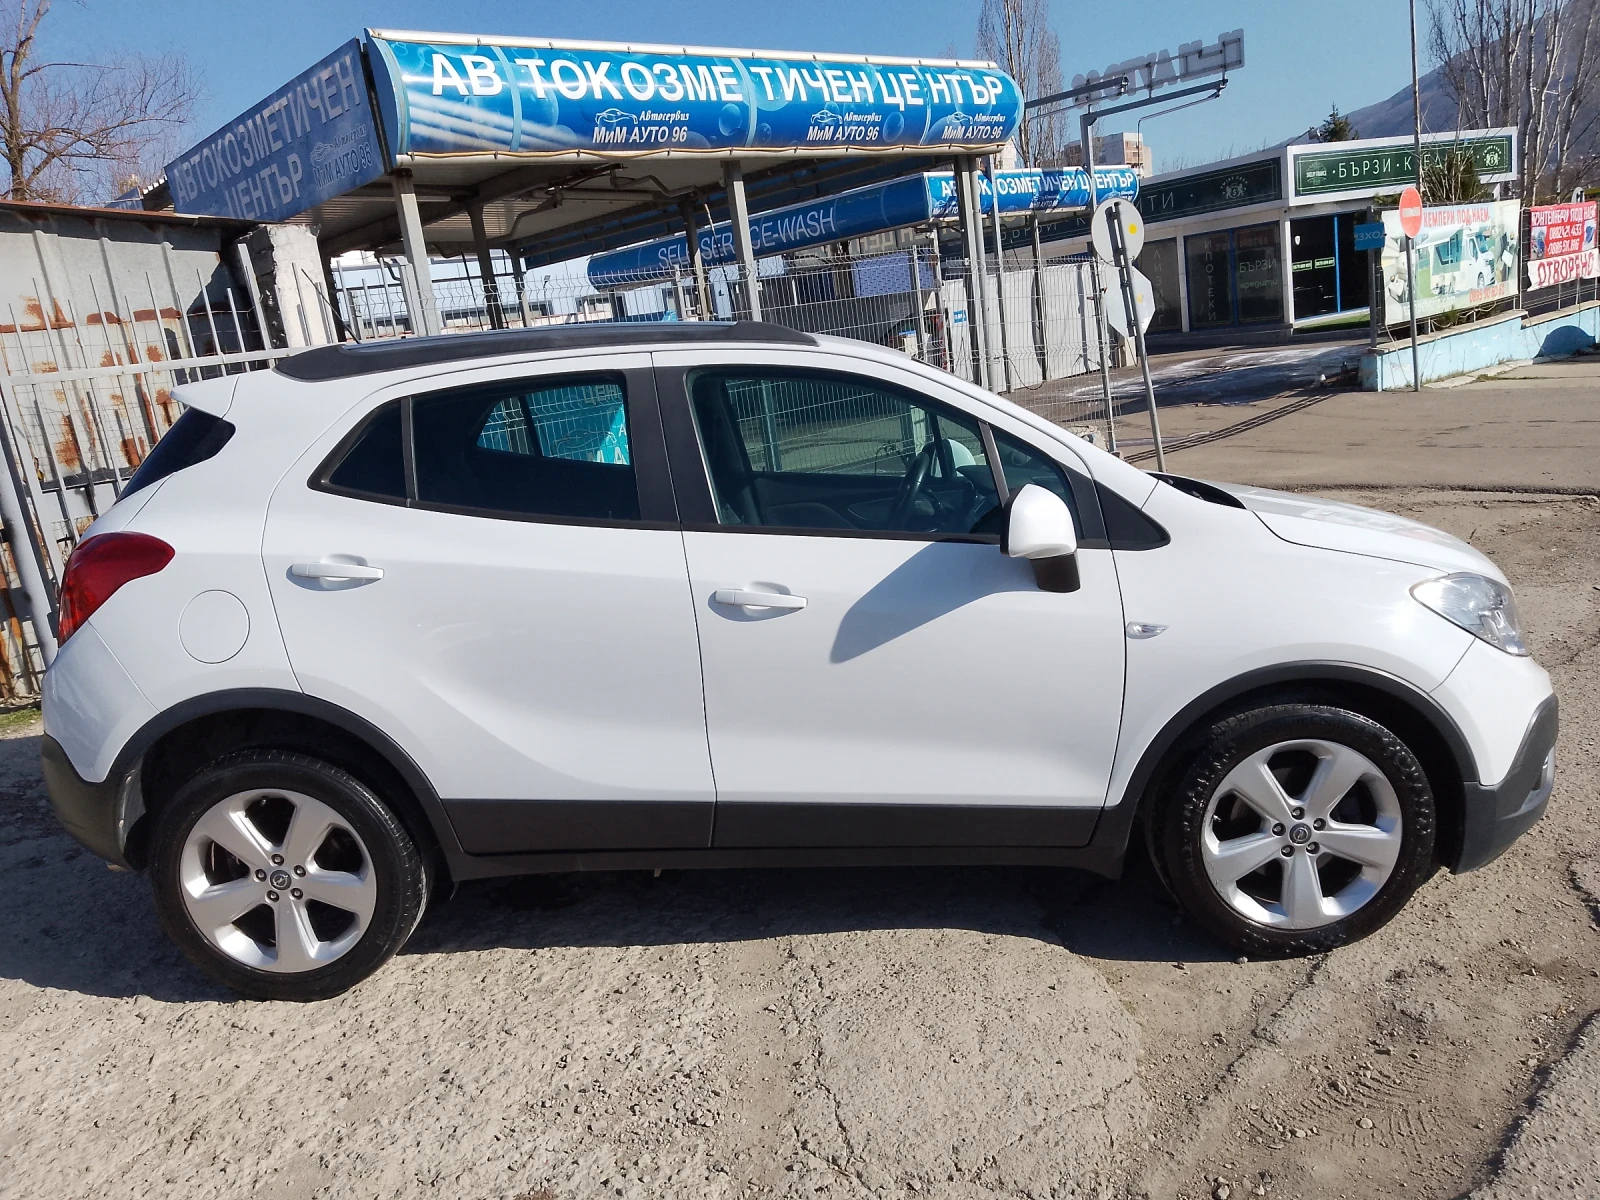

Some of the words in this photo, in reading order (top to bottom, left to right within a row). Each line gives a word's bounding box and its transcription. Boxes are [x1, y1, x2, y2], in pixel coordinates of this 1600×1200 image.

[639, 110, 689, 125] Автосервиз
[843, 112, 882, 123] Автосервиз
[973, 113, 1006, 123] Автосервиз
[173, 55, 361, 207] АВТОКОЗМЕТИЧЕН
[629, 126, 668, 143] АУТО
[671, 126, 687, 142] 96
[834, 125, 864, 141] АУТО
[865, 126, 879, 141] 96
[965, 125, 989, 139] АУТО
[990, 125, 1002, 139] 96
[359, 142, 372, 168] 96
[1338, 157, 1392, 178] БЪРЗИ
[224, 153, 303, 221] ЦЕНТЪР
[1239, 258, 1277, 273] БЪРЗИ
[1537, 251, 1594, 288] ОТВОРЕНО
[1153, 249, 1165, 325] ЛИЗИНГ
[1204, 240, 1217, 321] ИПОТЕКИ
